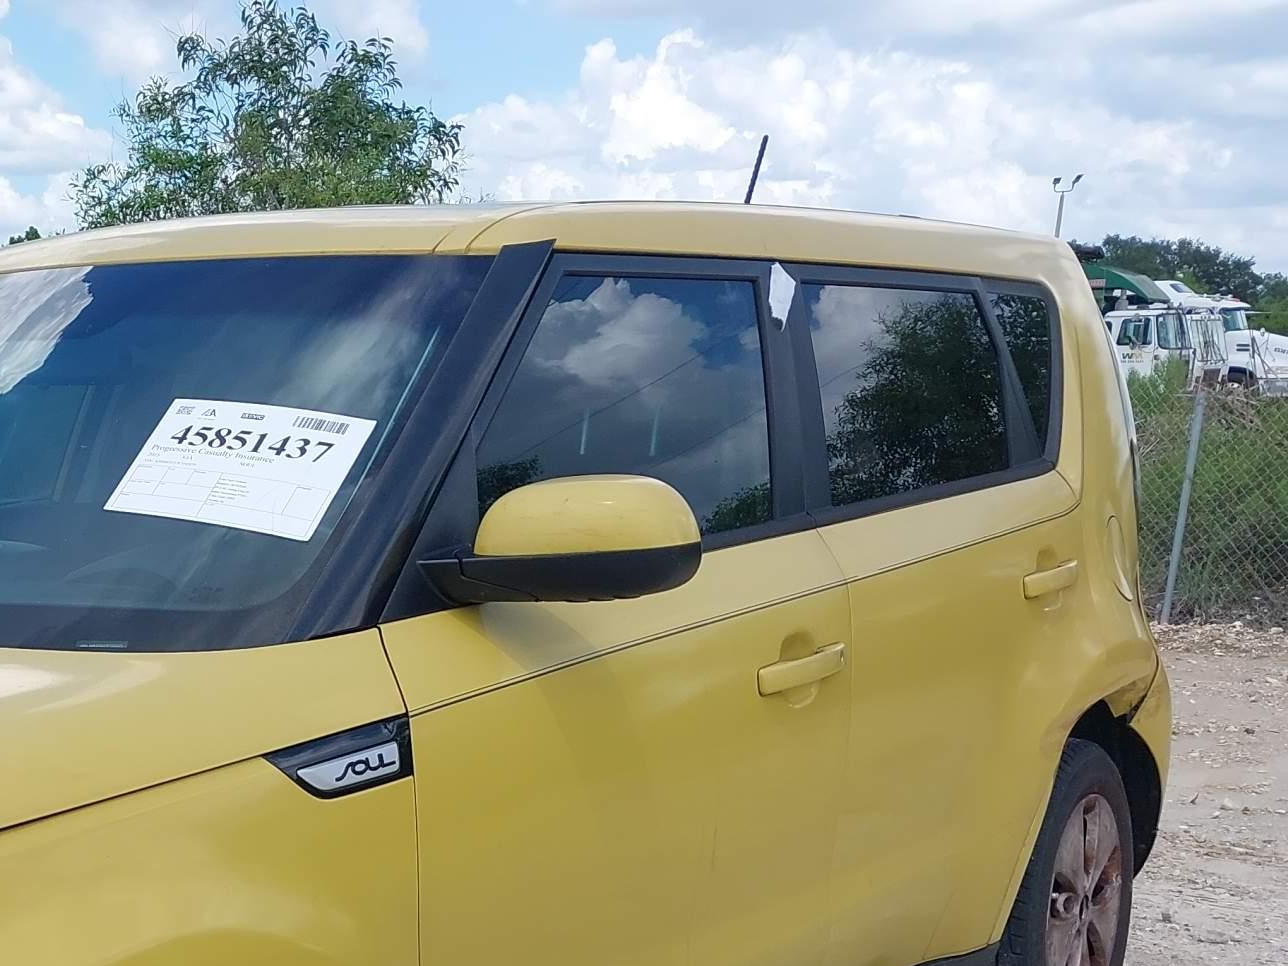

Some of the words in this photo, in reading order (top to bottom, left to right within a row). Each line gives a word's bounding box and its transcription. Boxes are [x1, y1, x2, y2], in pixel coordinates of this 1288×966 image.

[151, 444, 197, 455] Progressive
[198, 448, 233, 459] Casualty
[235, 452, 275, 464] Insurance
[170, 424, 335, 462] 45851437
[335, 753, 397, 782] SOUL
